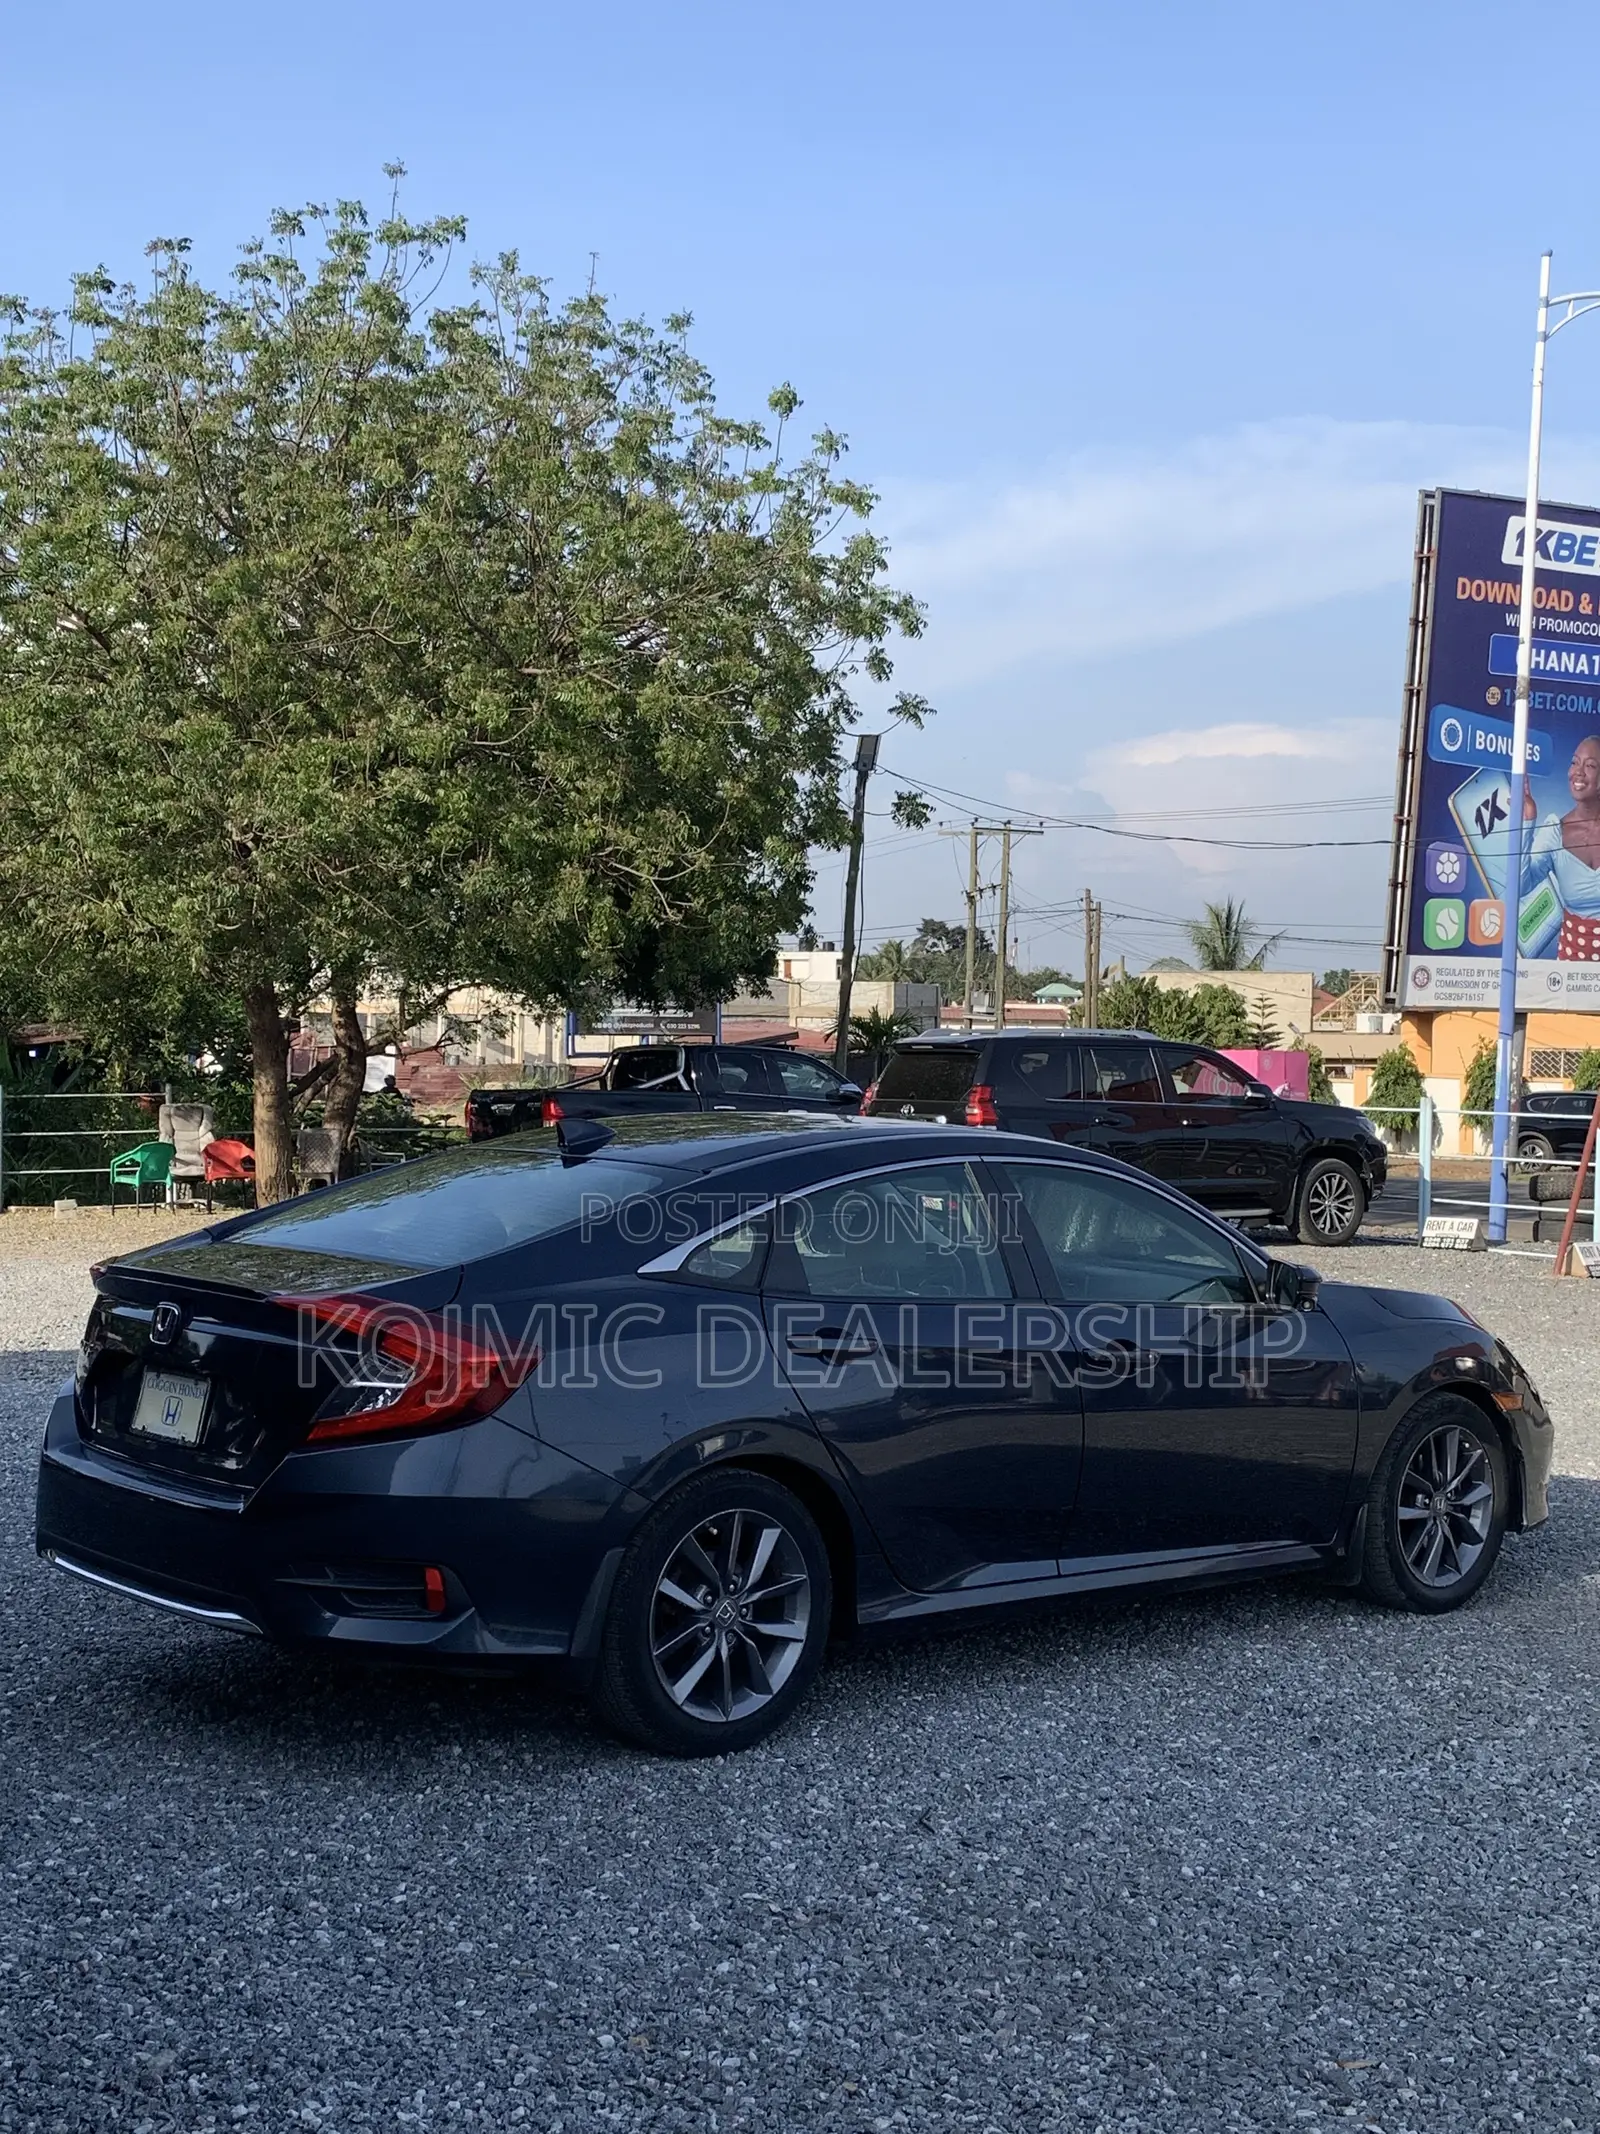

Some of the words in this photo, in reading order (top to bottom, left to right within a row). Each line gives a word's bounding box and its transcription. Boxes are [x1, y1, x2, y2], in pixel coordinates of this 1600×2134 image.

[1515, 526, 1600, 568] 1XBE
[1457, 577, 1574, 612] DOWNOAD
[1578, 593, 1593, 615] &
[1505, 612, 1536, 629] WIH
[1539, 616, 1600, 637] PROMOCO
[1516, 644, 1600, 676] HANA1
[1504, 688, 1600, 714] 1BET.COM.
[1475, 730, 1541, 762] BONUES
[1435, 967, 1475, 977] REGULATED
[1476, 969, 1485, 978] BY
[1487, 969, 1500, 979] THE
[1549, 976, 1561, 987] 18+
[1566, 972, 1580, 981] BET
[1435, 979, 1480, 989] COMMISSION
[1481, 981, 1490, 989] OF
[1566, 983, 1592, 992] GAMING
[1426, 1220, 1446, 1231] RENT
[1448, 1220, 1455, 1231] A
[1457, 1221, 1475, 1232] CAR
[147, 1376, 177, 1394] COGGIN
